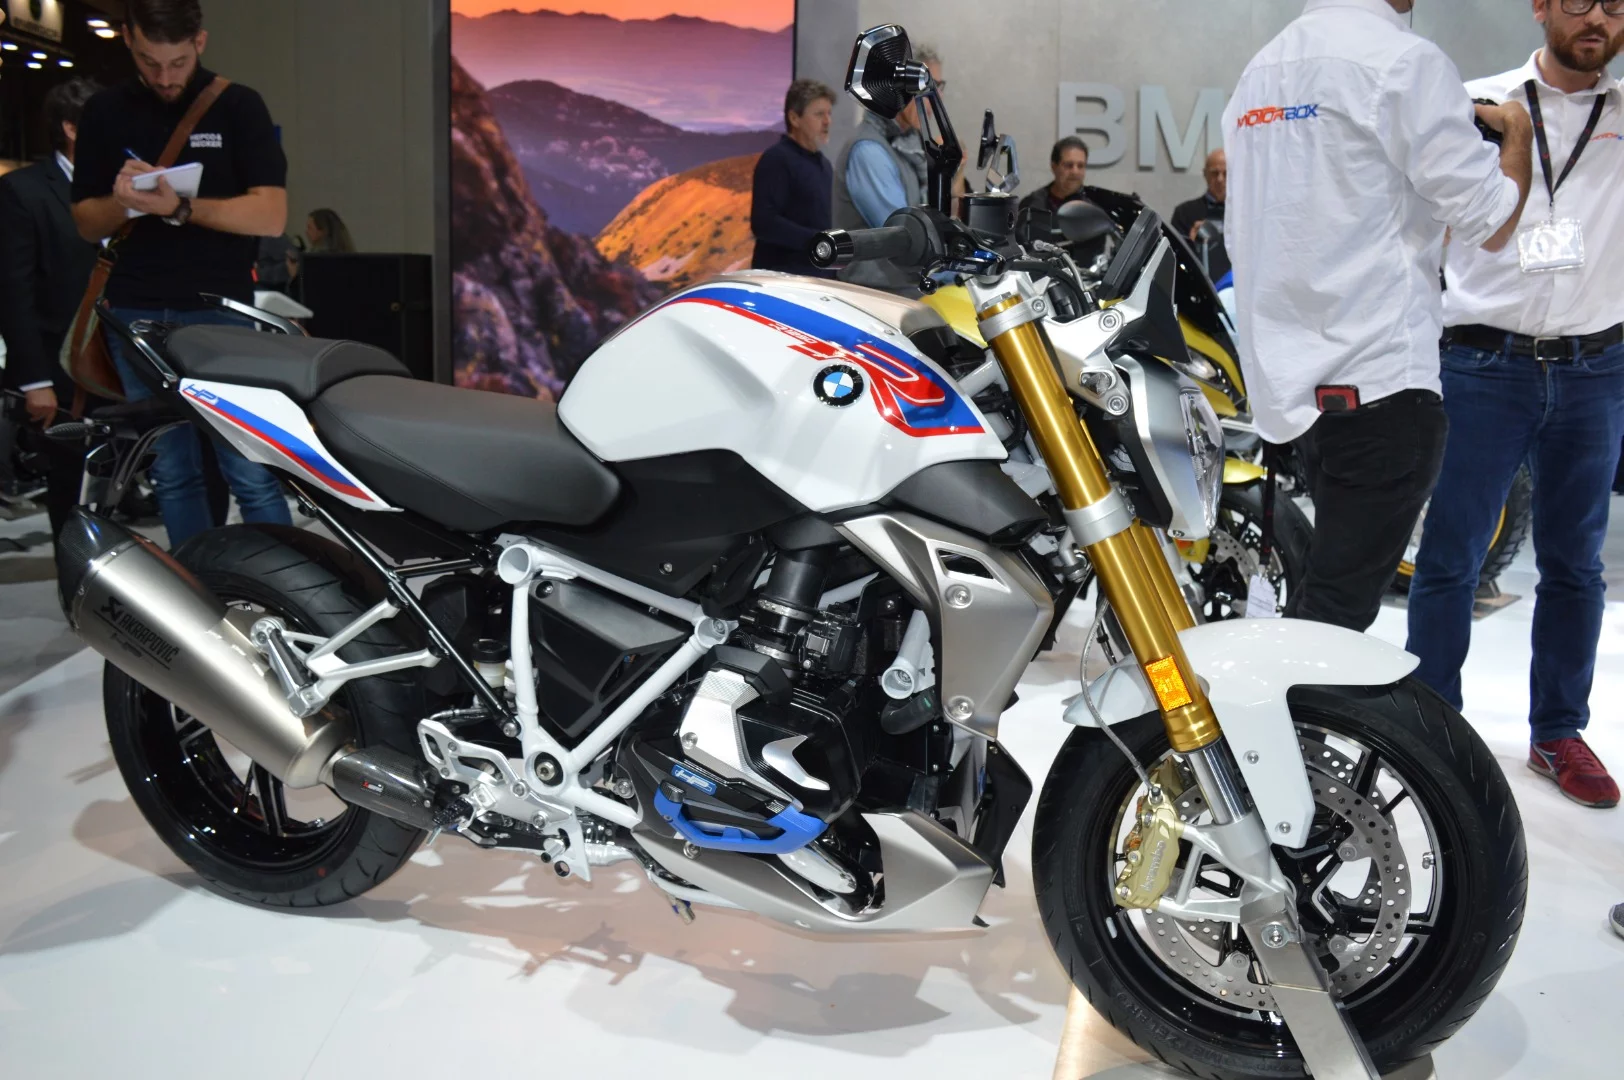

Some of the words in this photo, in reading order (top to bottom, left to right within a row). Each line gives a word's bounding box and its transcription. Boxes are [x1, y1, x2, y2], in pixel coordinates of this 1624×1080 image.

[1237, 104, 1319, 128] MOTORBOX
[1057, 82, 1232, 172] BM
[183, 383, 217, 400] HP
[674, 769, 710, 788] HP
